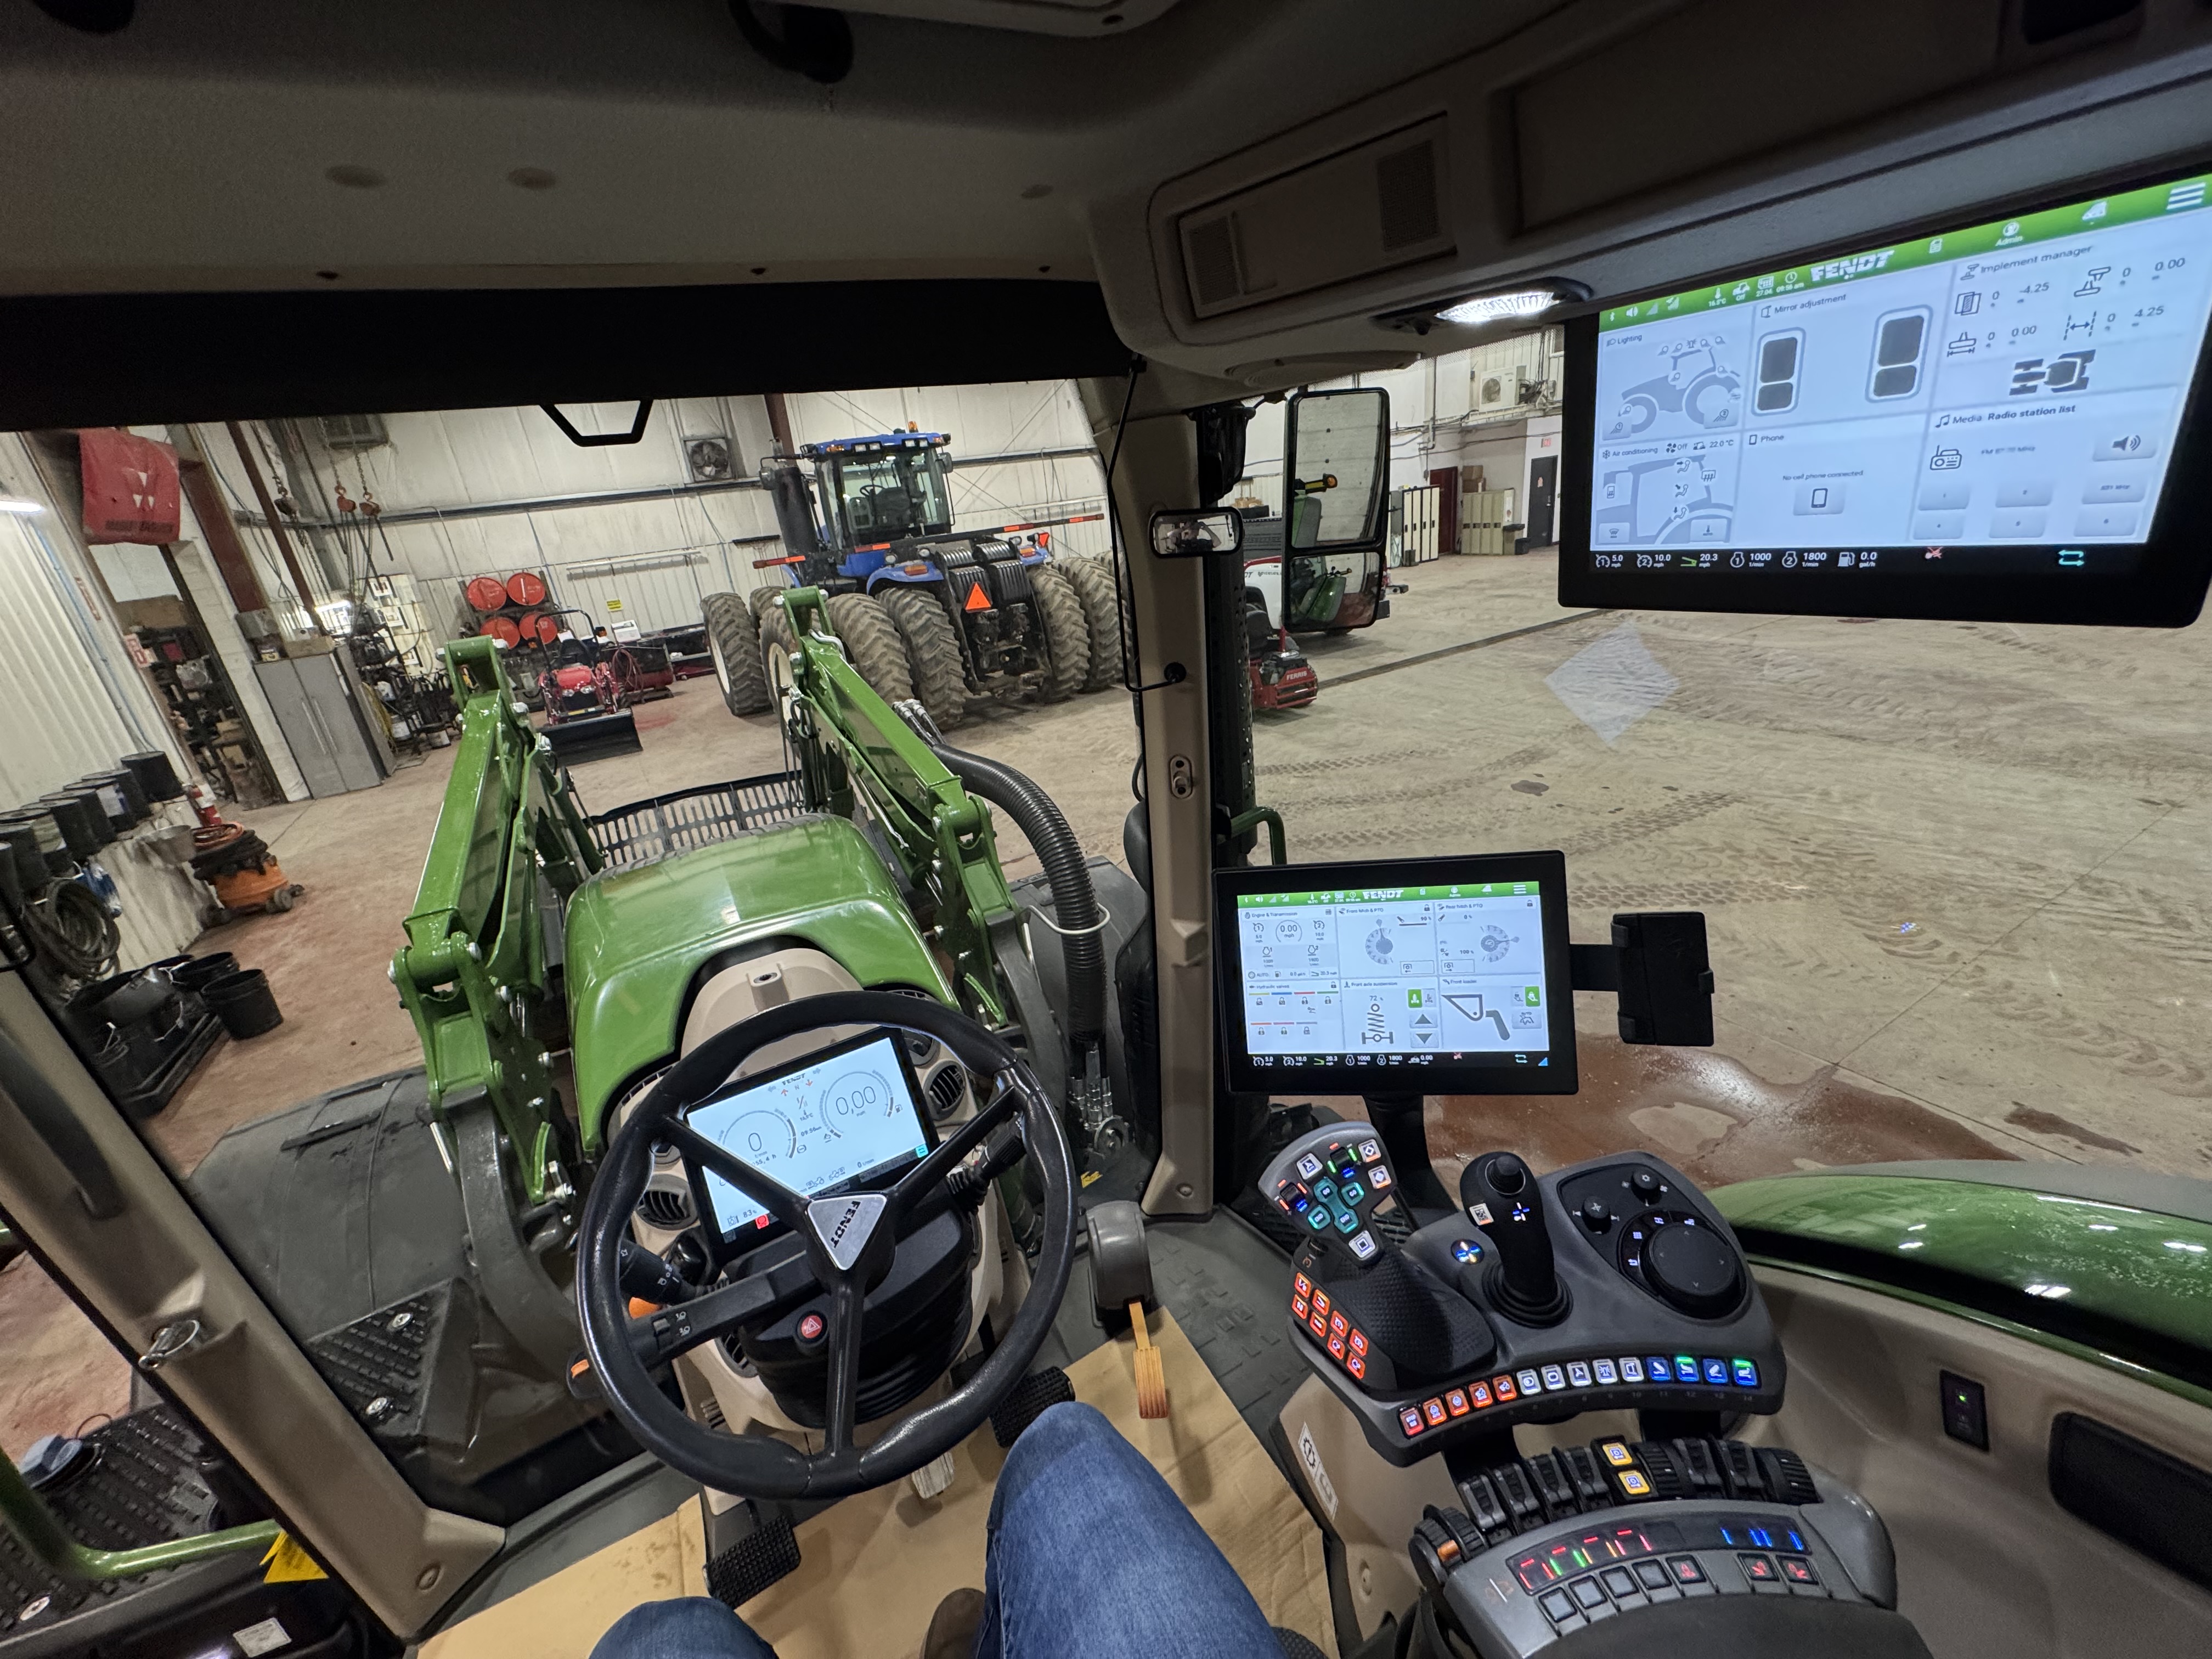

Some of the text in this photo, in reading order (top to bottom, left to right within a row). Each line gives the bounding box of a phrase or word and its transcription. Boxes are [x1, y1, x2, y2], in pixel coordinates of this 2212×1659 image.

[1996, 235, 2023, 247] Admin
[1981, 245, 2093, 275] Implement manager
[2155, 257, 2186, 272] 0.00
[1810, 250, 1895, 282] FENDT
[1774, 294, 1847, 315] Mirror adjustment
[2012, 325, 2037, 337] 0.00
[1618, 335, 1642, 345] Lighting
[1988, 410, 2017, 420] Radio
[2019, 405, 2056, 418] station
[2058, 404, 2076, 415] list
[1760, 435, 1784, 443] Phone
[1677, 443, 1688, 451] Off
[1709, 440, 1725, 449] 22.0
[1622, 447, 1658, 458] conditioning
[1805, 472, 1826, 482] phone
[1827, 470, 1864, 479] connected
[1612, 554, 1623, 562] 5.0
[1655, 554, 1671, 562] 10.0
[1700, 554, 1718, 562] 20.3
[1750, 552, 1771, 561] 1000
[1803, 552, 1827, 561] 1800
[1860, 551, 1877, 560] 0.0
[1286, 670, 1307, 681] FERRIS
[1363, 890, 1404, 900] FENDT
[1280, 924, 1297, 933] 0.00
[782, 1073, 805, 1086] FENDT
[748, 1132, 762, 1152] 0
[1323, 1187, 1330, 1195] GO
[743, 1209, 752, 1218] 83
[1314, 1213, 1324, 1222] END
[1340, 1214, 1350, 1223] END
[831, 1200, 861, 1249] FENDT
